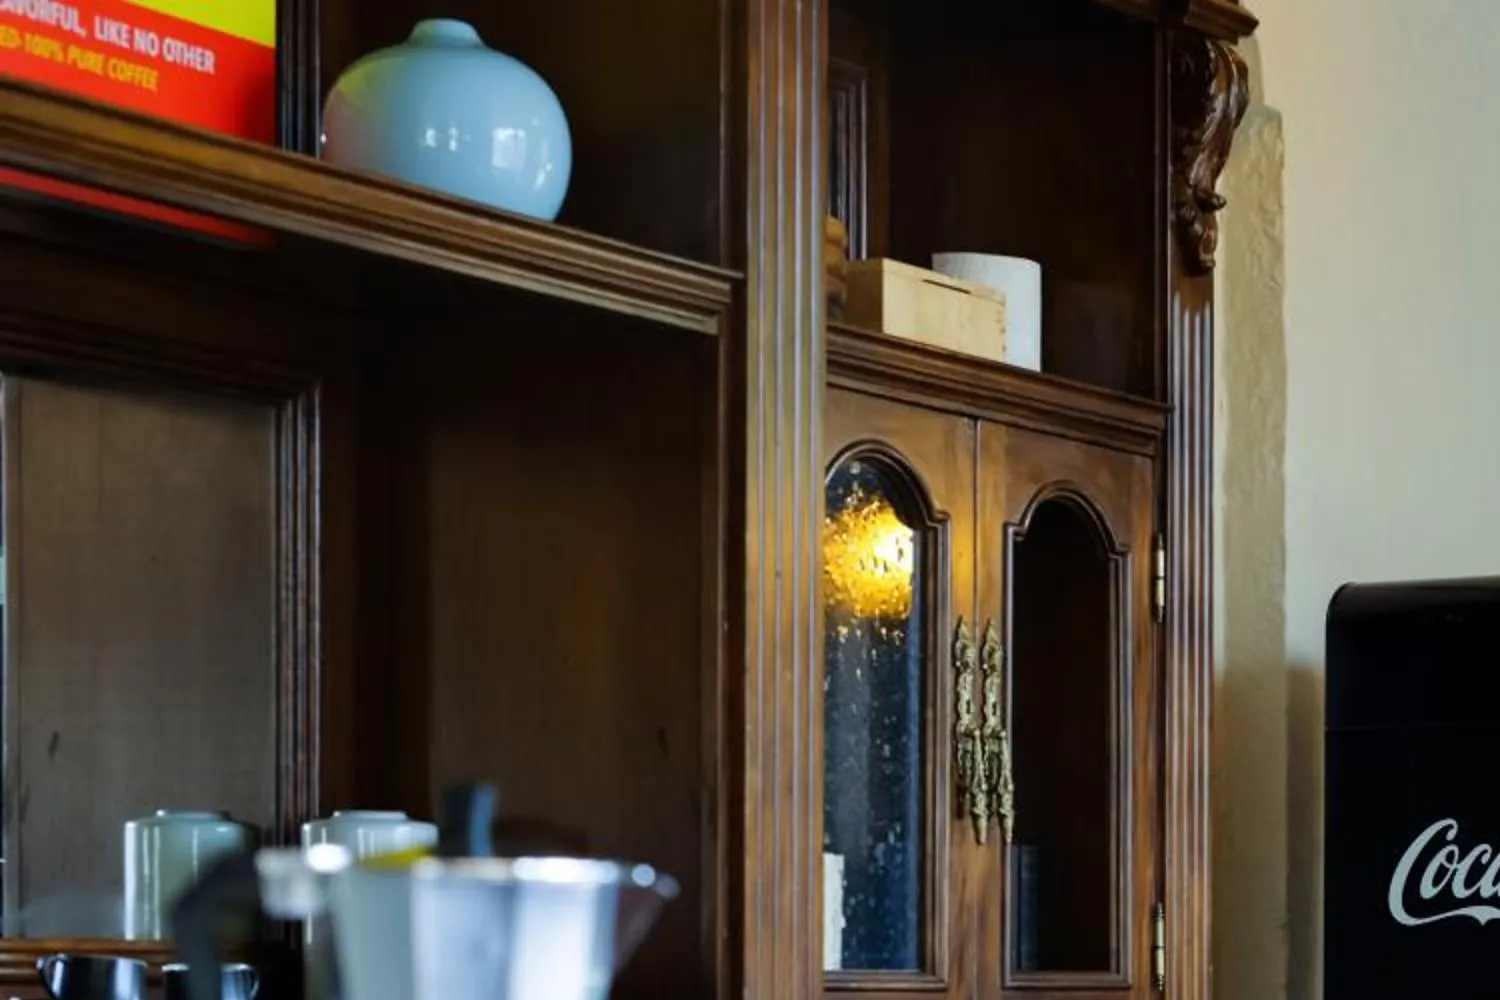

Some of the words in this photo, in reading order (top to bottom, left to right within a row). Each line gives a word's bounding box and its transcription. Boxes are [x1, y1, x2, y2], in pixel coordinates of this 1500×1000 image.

[67, 45, 105, 76] PURE
[107, 57, 159, 91] COFFEE
[94, 15, 131, 48] LIKE
[133, 27, 160, 58] NO
[163, 36, 215, 74] OTHER
